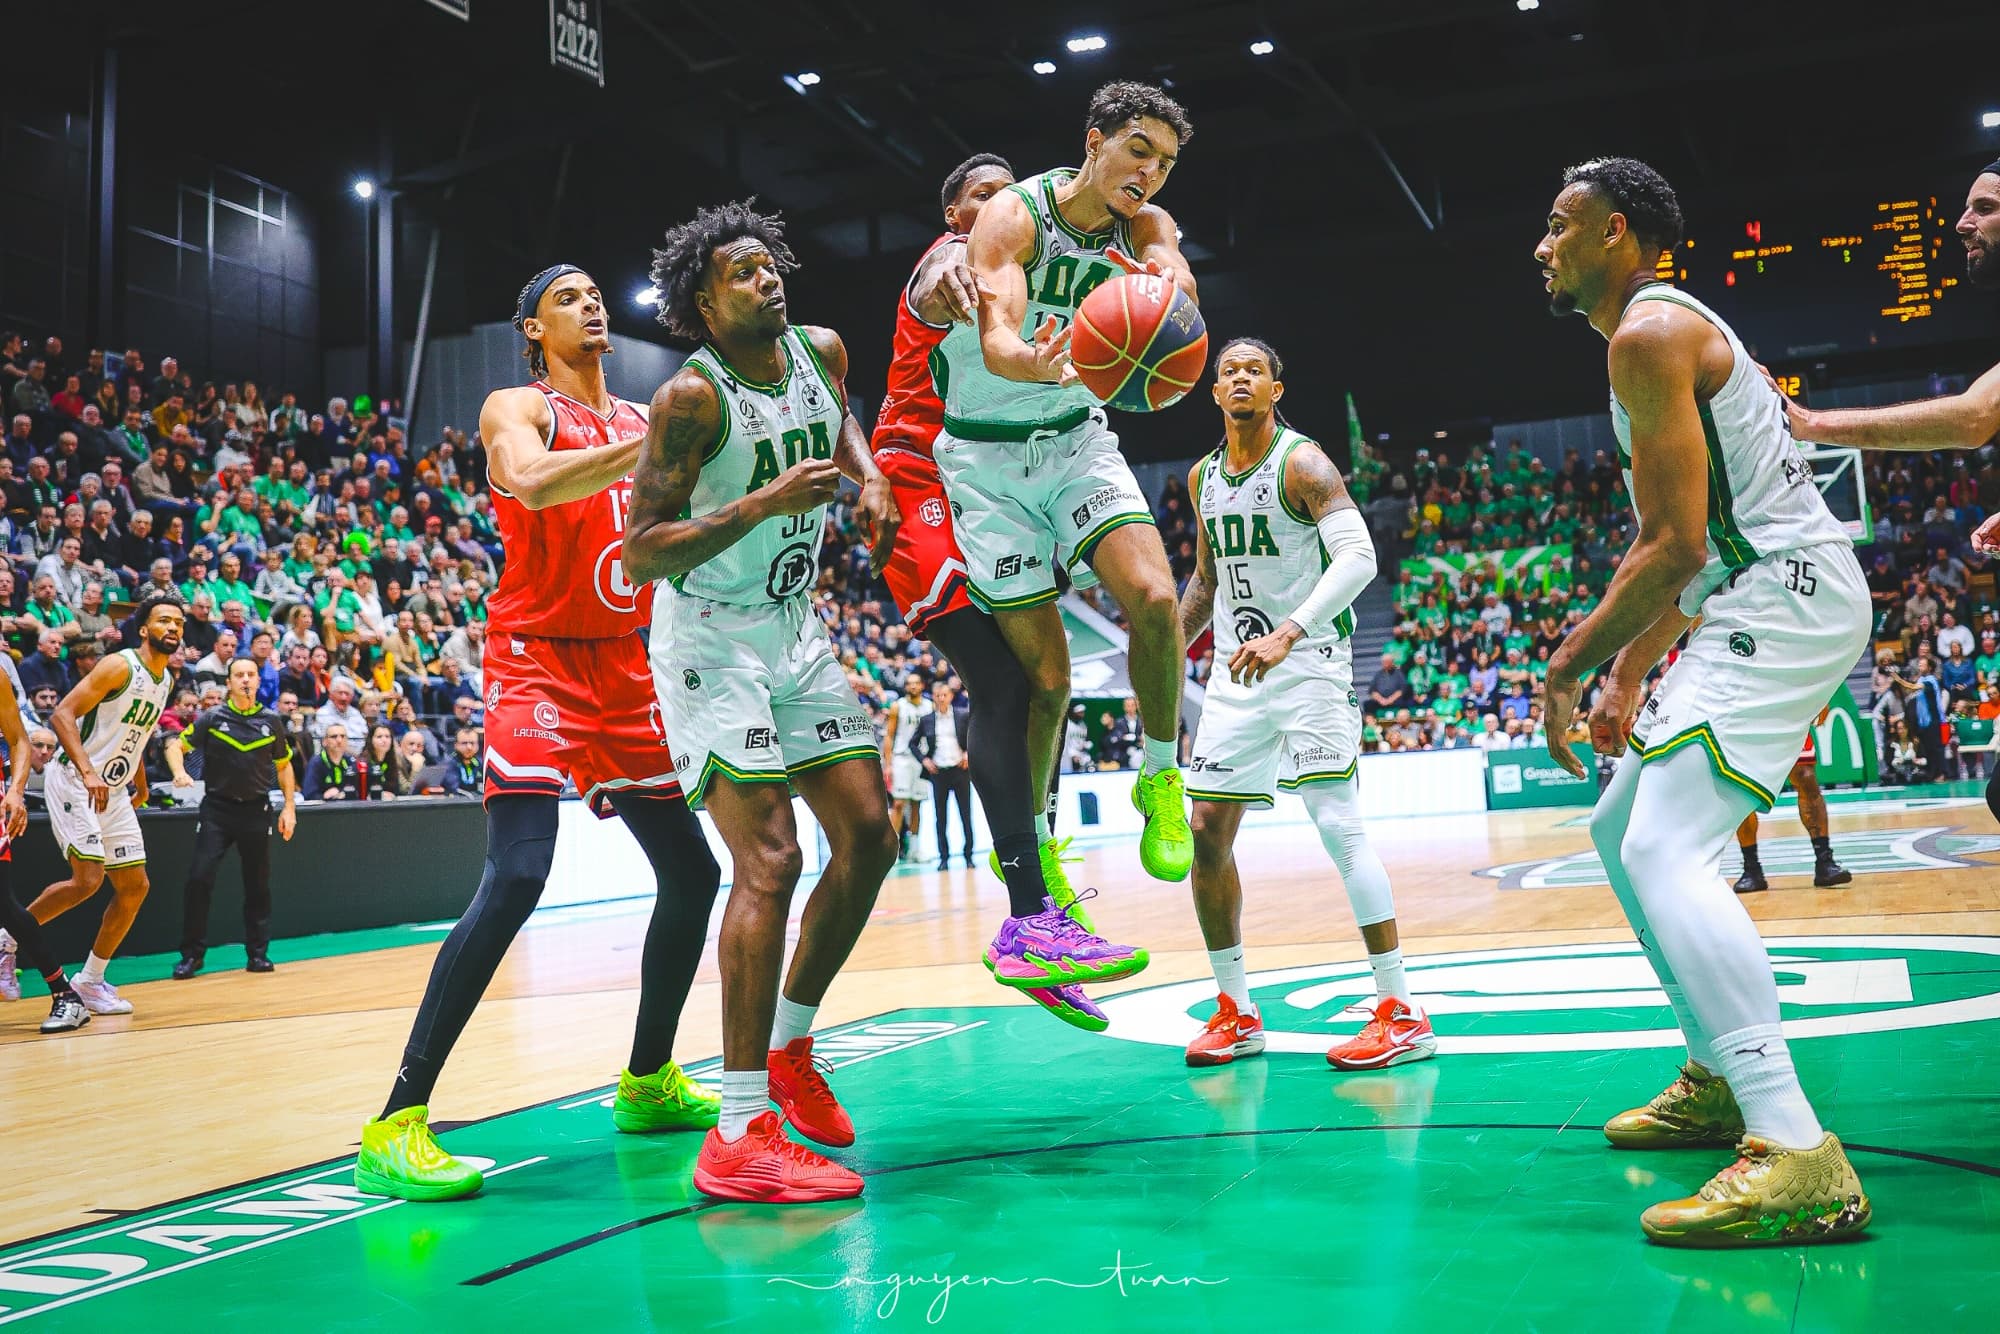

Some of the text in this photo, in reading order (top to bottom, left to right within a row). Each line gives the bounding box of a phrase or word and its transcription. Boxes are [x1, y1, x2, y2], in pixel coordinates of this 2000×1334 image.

[556, 13, 598, 68] 2022
[1089, 486, 1120, 505] CAISSE
[922, 504, 943, 522] CB
[1206, 514, 1280, 558] ADA
[997, 555, 1022, 578] isf
[1227, 563, 1253, 600] 15
[1784, 559, 1817, 597] 35
[748, 729, 769, 749] isf
